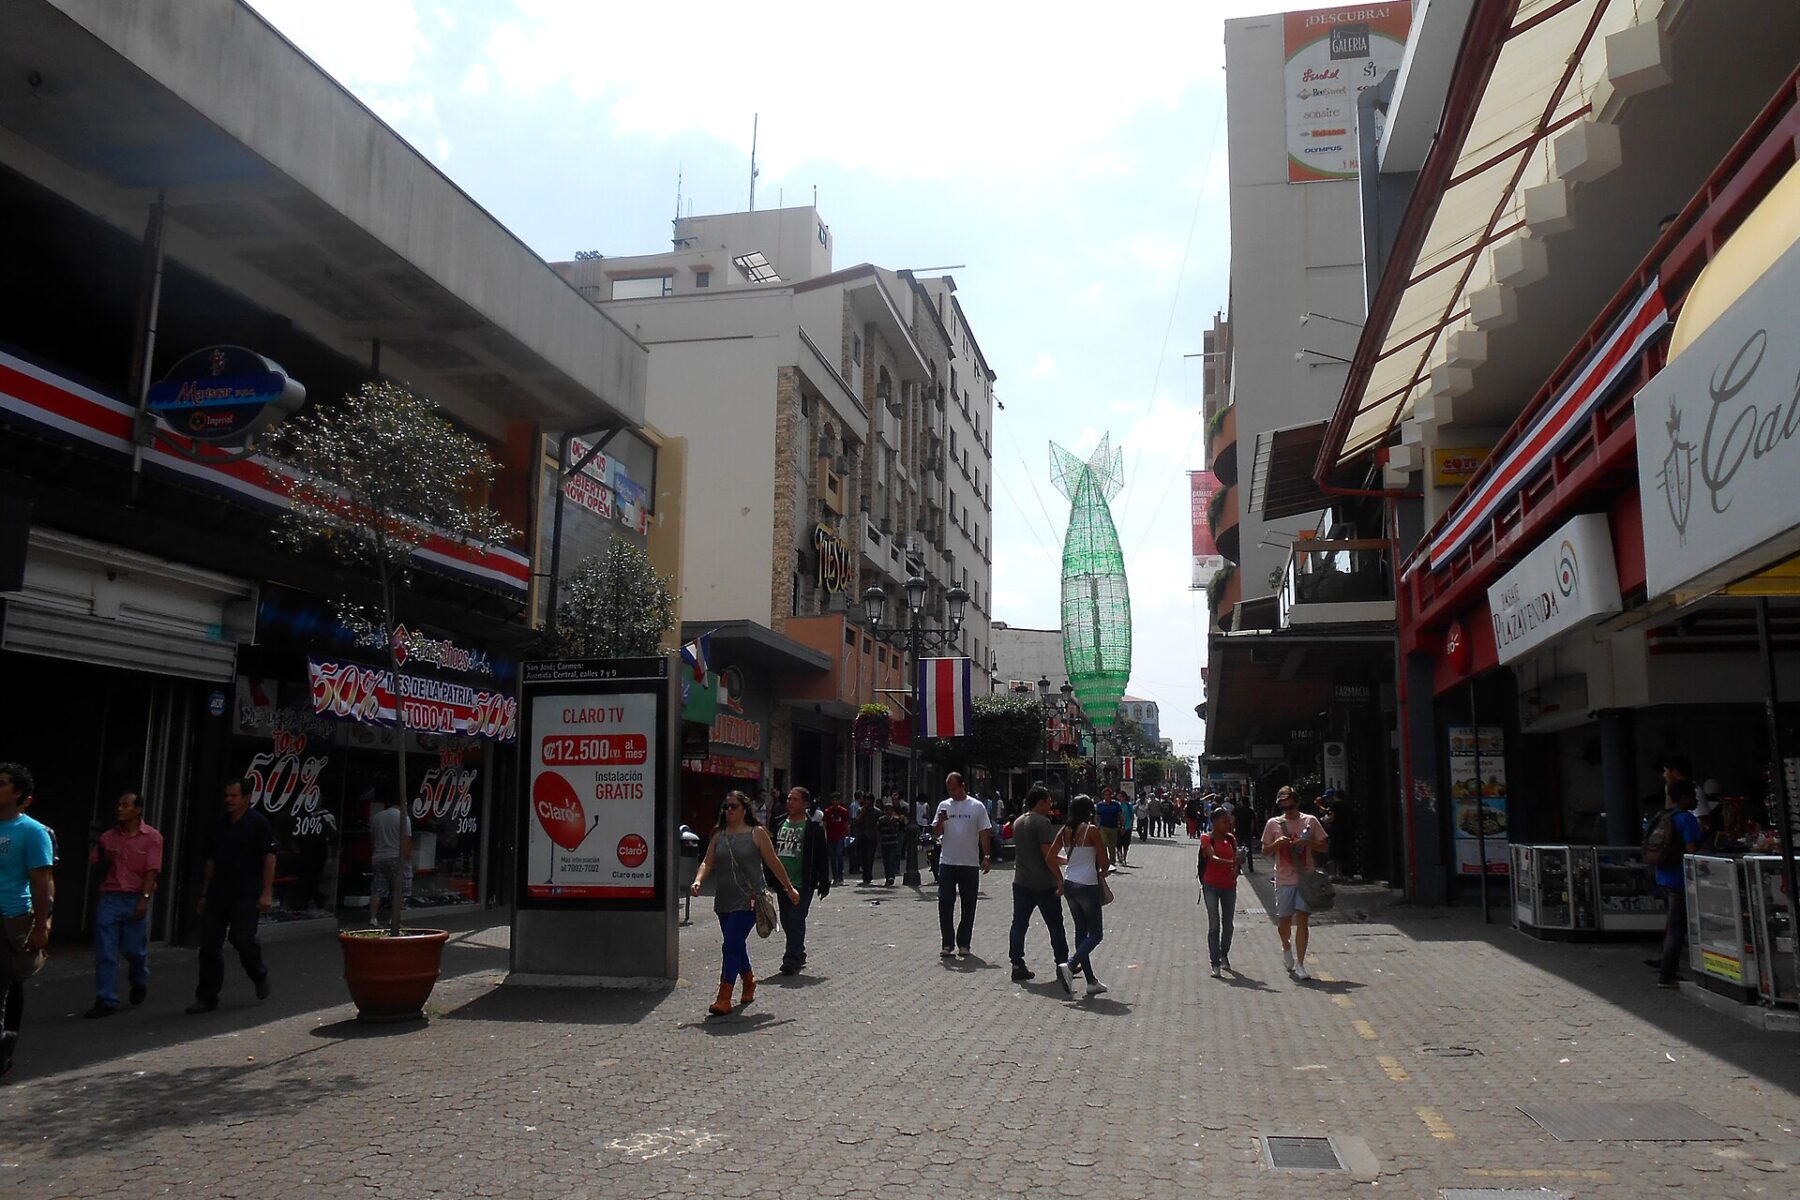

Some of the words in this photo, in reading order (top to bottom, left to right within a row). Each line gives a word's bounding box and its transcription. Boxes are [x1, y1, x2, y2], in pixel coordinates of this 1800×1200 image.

[1306, 8, 1390, 28] ¡DESCUBRA!
[1332, 37, 1367, 53] GALERIA
[1304, 145, 1342, 154] OLYMPUS
[207, 413, 233, 425] Imperial
[572, 441, 606, 473] OCTPUS
[587, 495, 611, 517] OPEN
[526, 672, 551, 680] Avenida
[580, 670, 599, 678] calles
[612, 669, 617, 677] 9
[314, 662, 386, 722] 50%
[386, 671, 410, 698] MES
[411, 678, 425, 698] DE
[426, 680, 441, 701] LA
[442, 683, 474, 706] PATRIA
[1335, 685, 1370, 697] FARMACIA
[404, 702, 439, 731] TODO
[439, 708, 456, 734] AL
[467, 691, 517, 741] 50%
[563, 708, 605, 724] CLARO
[609, 708, 624, 723] TV
[709, 713, 761, 750] UIZNOS
[625, 740, 634, 750] al
[244, 753, 329, 817] 50%
[595, 770, 643, 782] Instalación
[412, 768, 478, 820] 50%
[595, 783, 644, 800] GRATIS
[538, 799, 577, 822] Claro
[292, 816, 323, 836] 30%
[456, 818, 478, 834] 30%
[618, 845, 643, 856] Claro
[612, 871, 631, 879] Claro
